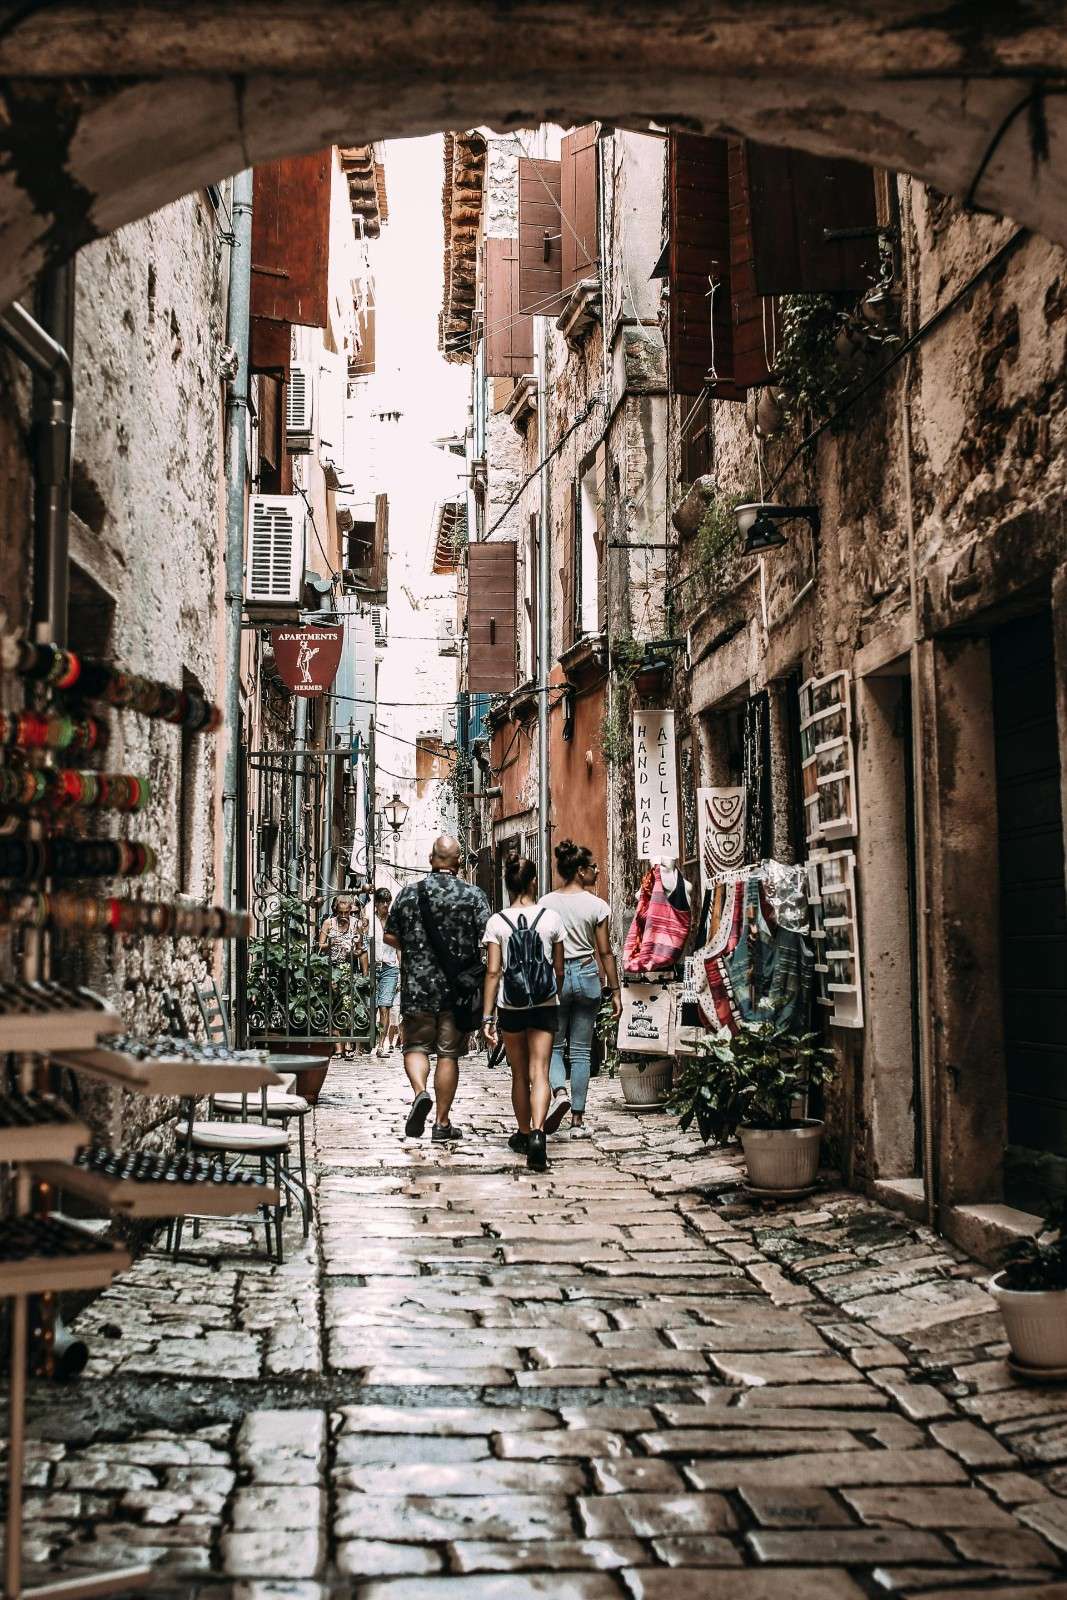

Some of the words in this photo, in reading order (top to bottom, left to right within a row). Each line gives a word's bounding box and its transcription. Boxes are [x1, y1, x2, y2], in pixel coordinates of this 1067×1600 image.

[637, 725, 649, 785] HAND
[657, 727, 672, 847] ATELIER
[640, 797, 651, 854] MADE
